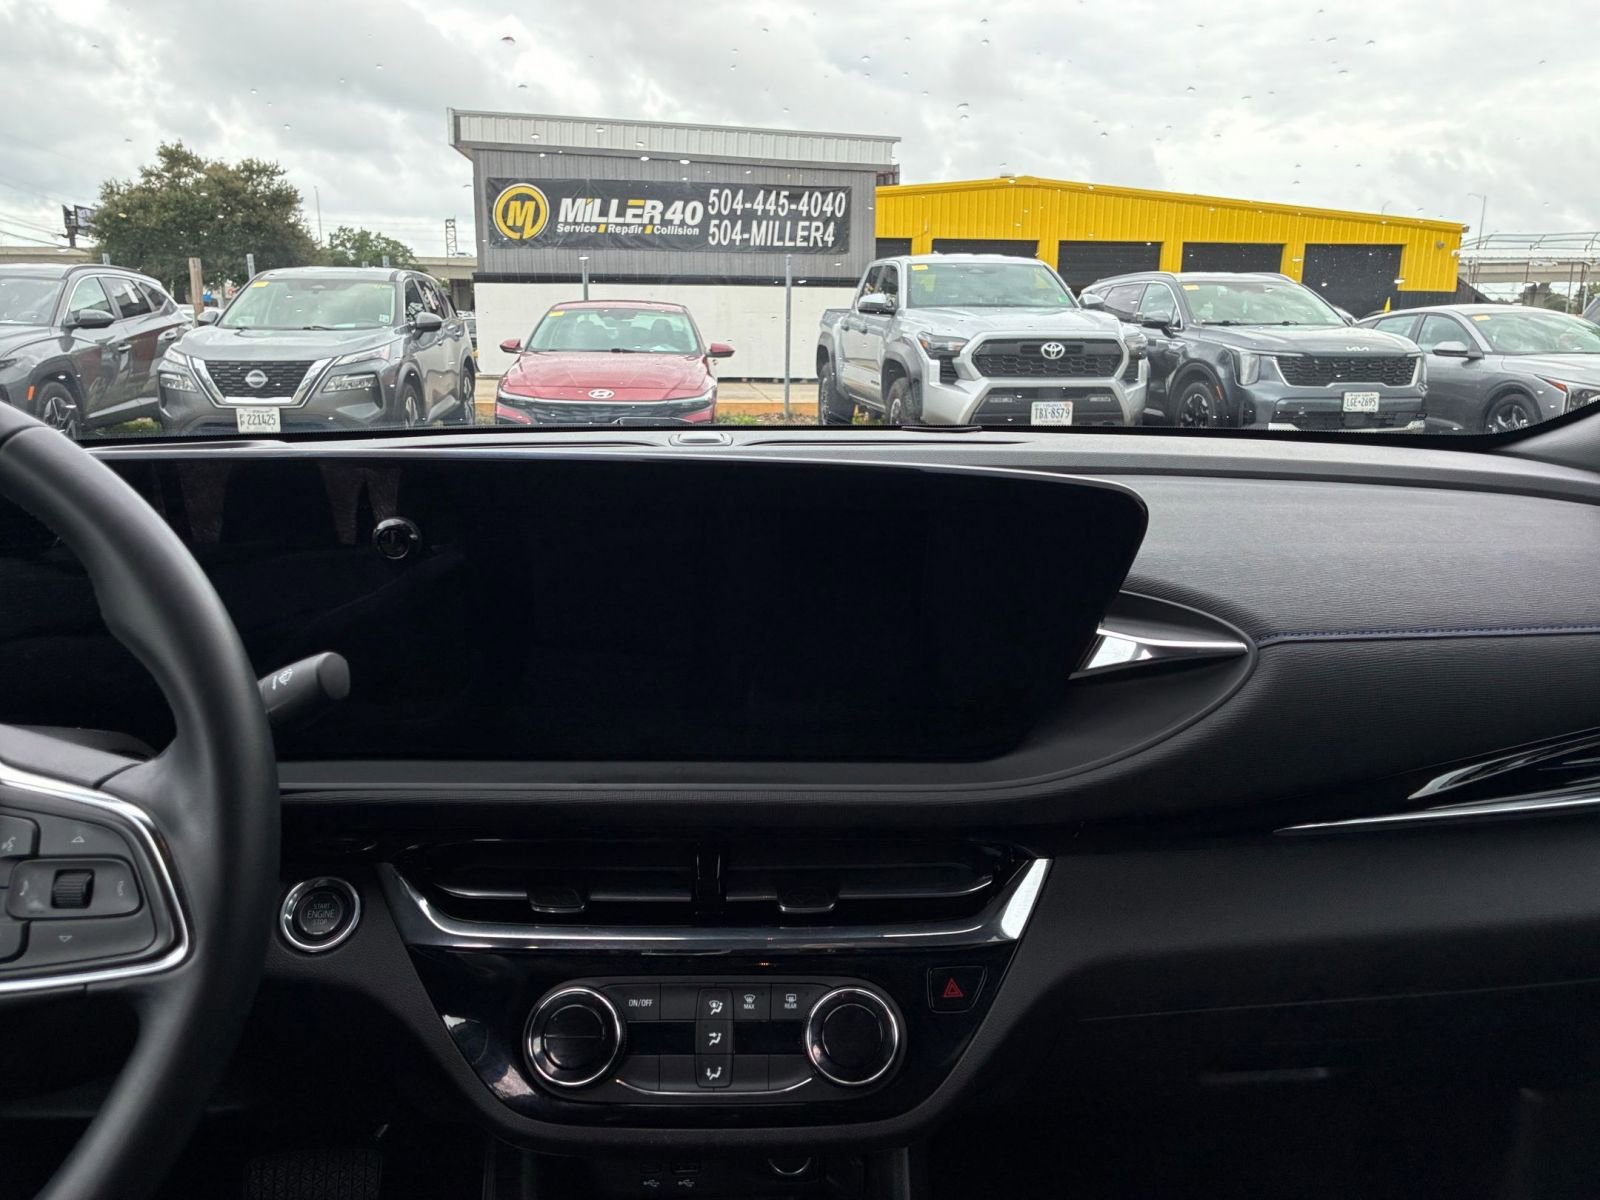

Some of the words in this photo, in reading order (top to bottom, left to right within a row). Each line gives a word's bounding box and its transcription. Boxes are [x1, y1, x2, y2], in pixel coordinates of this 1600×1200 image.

[707, 188, 846, 218] 504-445-4040
[556, 224, 597, 233] Service
[607, 224, 643, 235] Repair
[653, 225, 700, 235] Collision
[707, 219, 835, 248] 504-MILLER4
[306, 909, 336, 919] ENGINE
[628, 999, 653, 1008] ON/OFF
